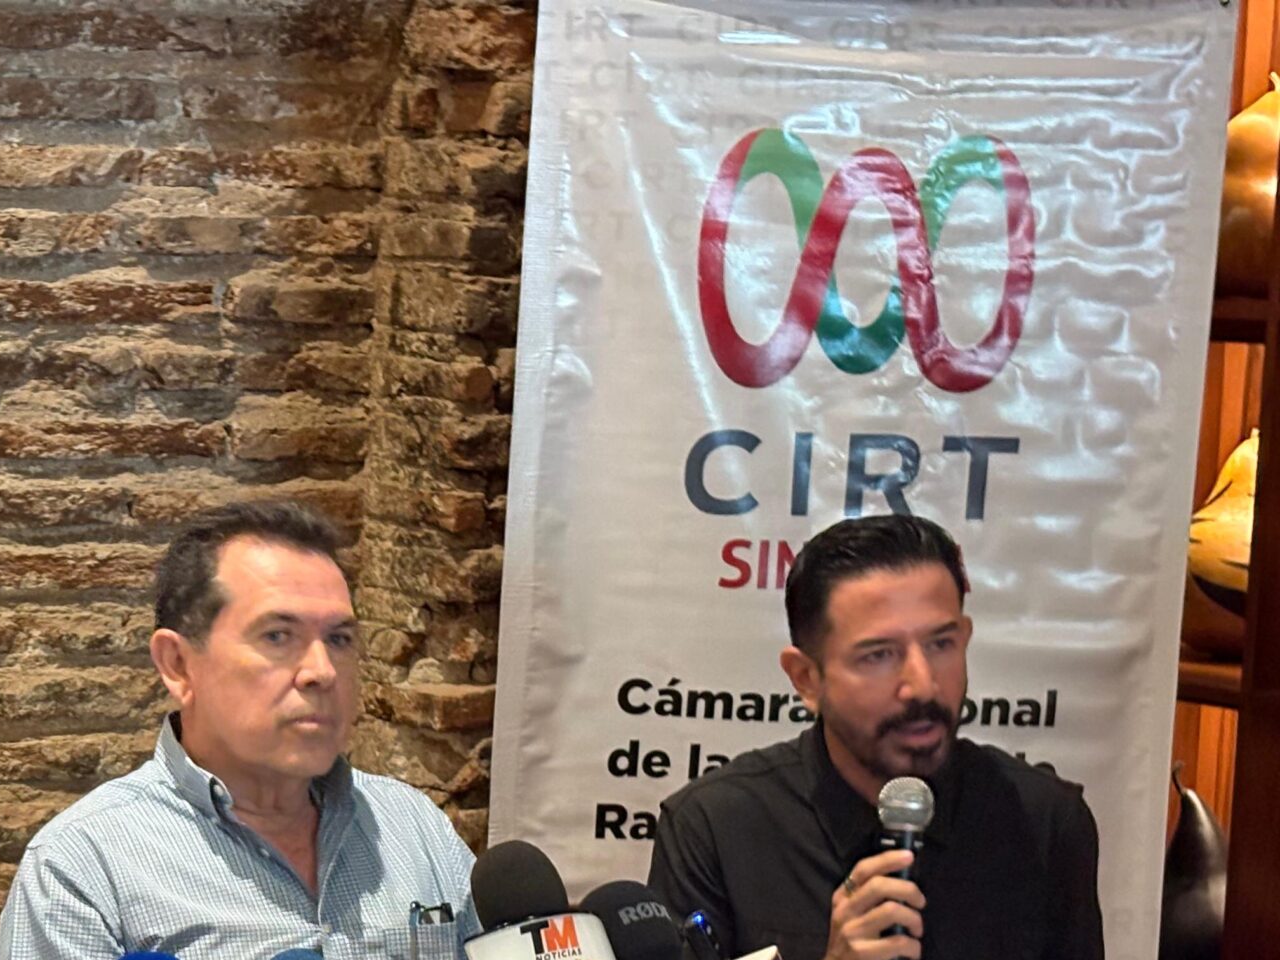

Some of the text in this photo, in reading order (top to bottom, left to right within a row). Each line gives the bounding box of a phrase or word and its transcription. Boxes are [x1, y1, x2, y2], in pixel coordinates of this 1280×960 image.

[684, 429, 1020, 521] CIRT
[617, 677, 1058, 728] Cámara onal
[607, 739, 671, 778] de
[618, 901, 673, 926] RØD
[520, 914, 579, 955] TM
